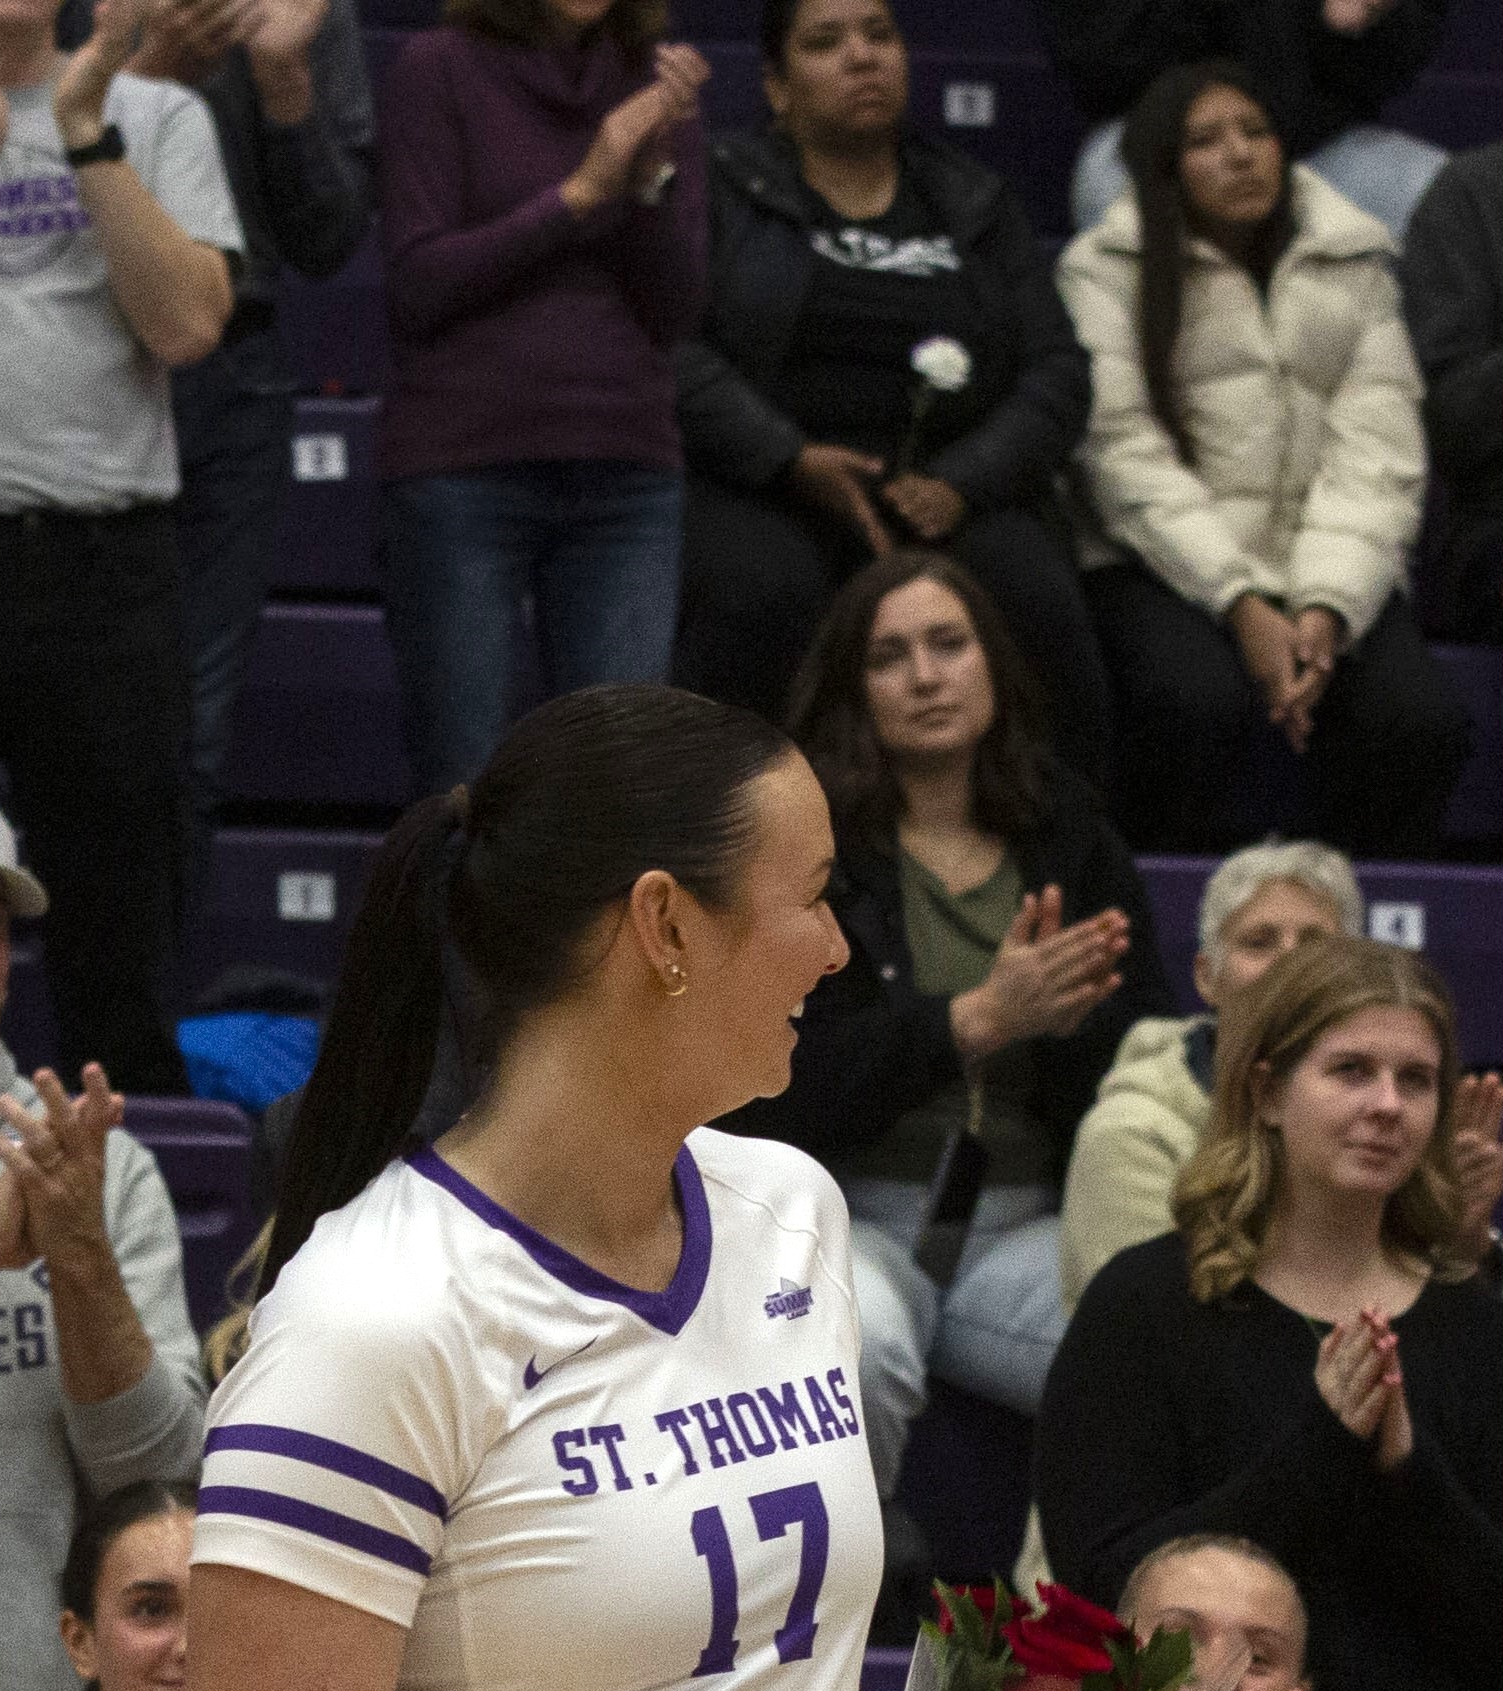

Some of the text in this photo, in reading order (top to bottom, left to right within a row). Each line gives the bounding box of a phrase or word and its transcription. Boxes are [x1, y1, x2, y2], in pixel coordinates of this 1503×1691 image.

[553, 1368, 859, 1497] ST. THOMAS
[691, 1482, 830, 1679] 17
